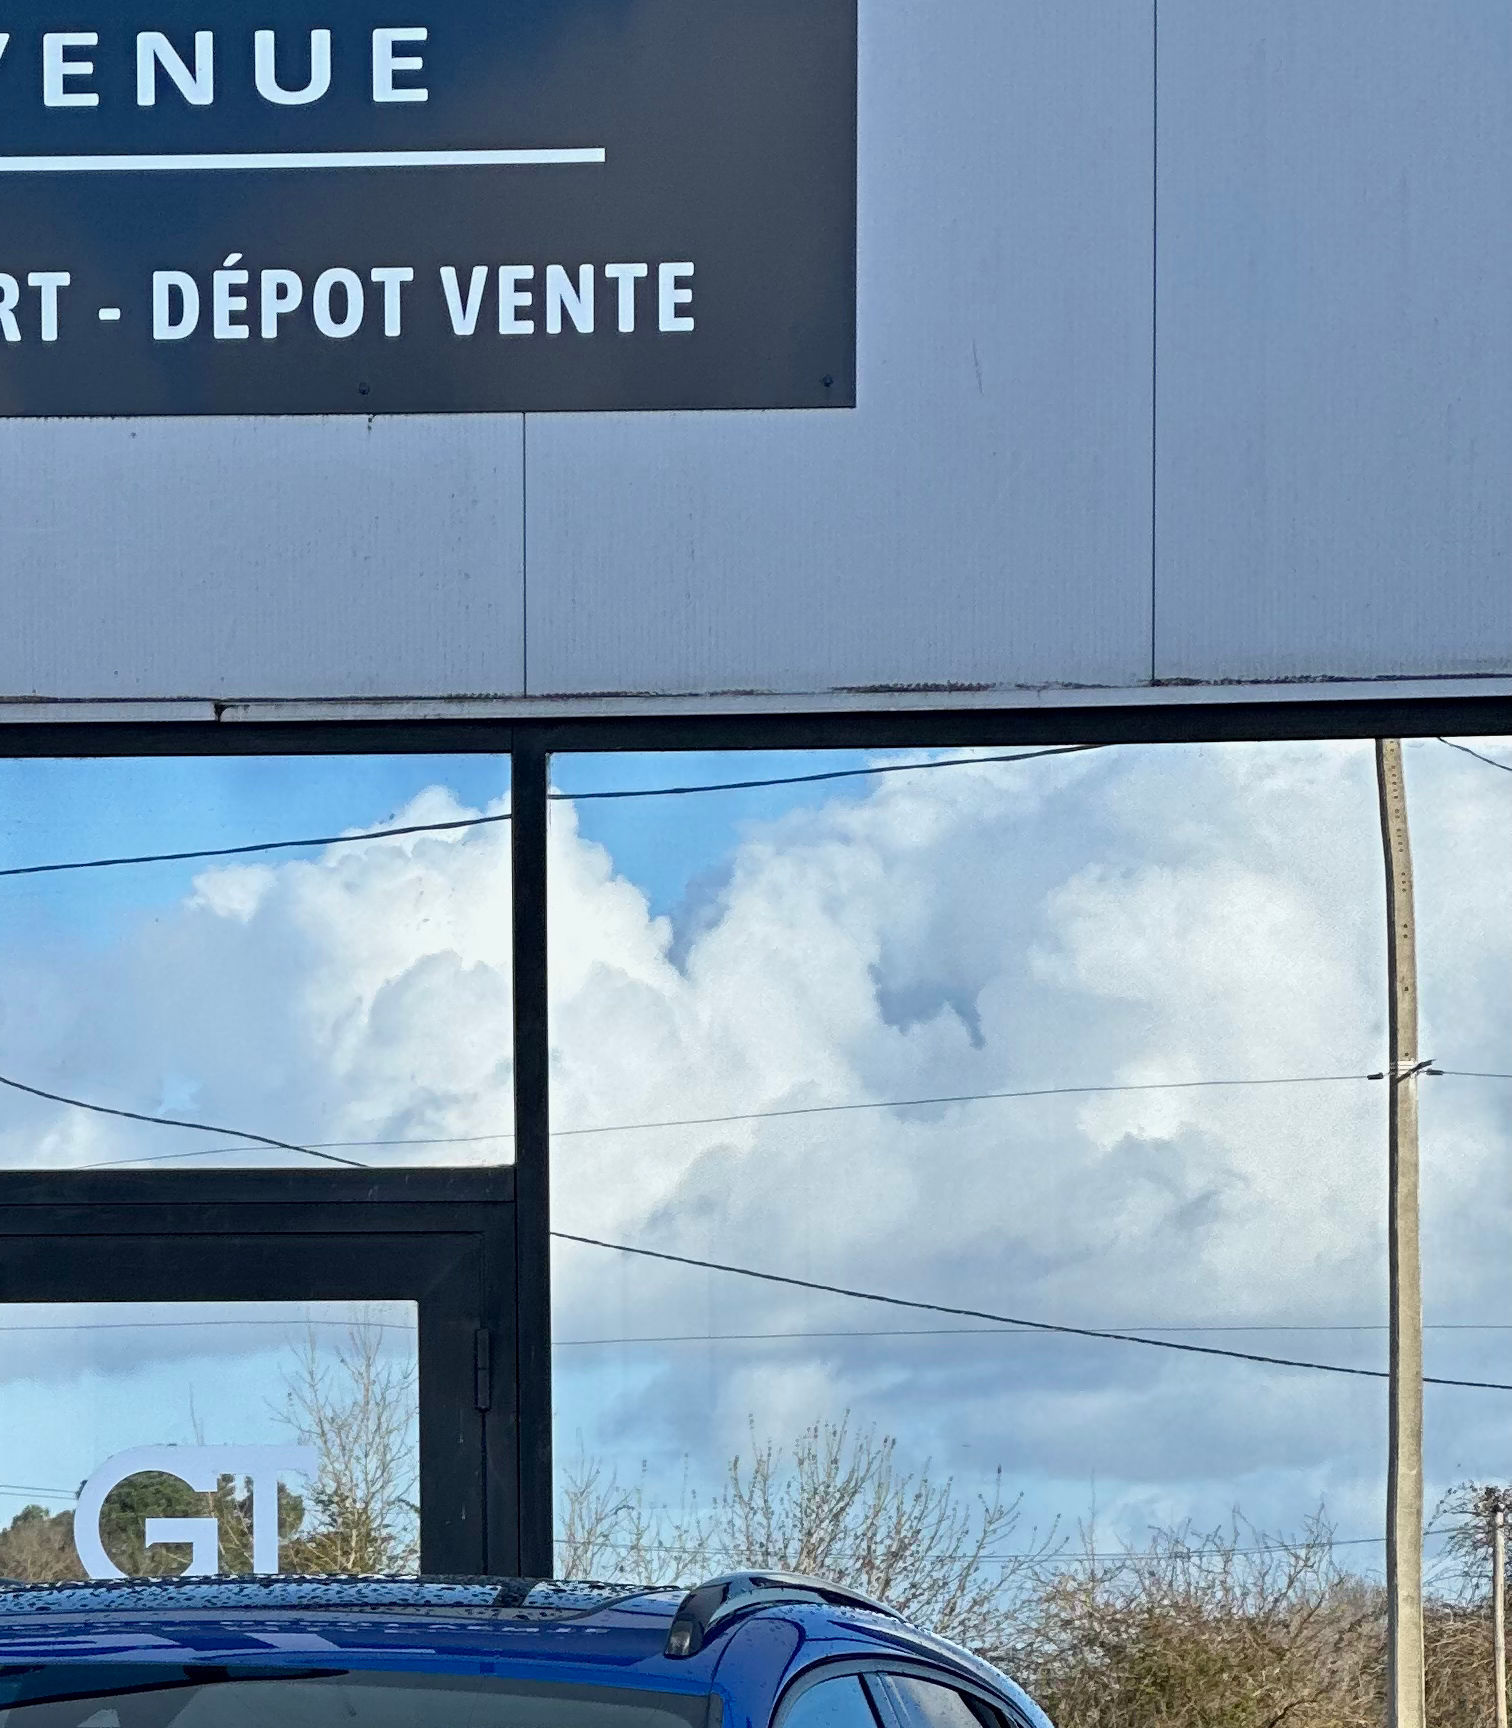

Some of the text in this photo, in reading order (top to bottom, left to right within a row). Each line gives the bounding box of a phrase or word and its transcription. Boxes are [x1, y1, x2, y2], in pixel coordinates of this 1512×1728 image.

[152, 252, 415, 340] DÉPOT
[439, 261, 696, 336] VENTE
[74, 1443, 318, 1580] GT
